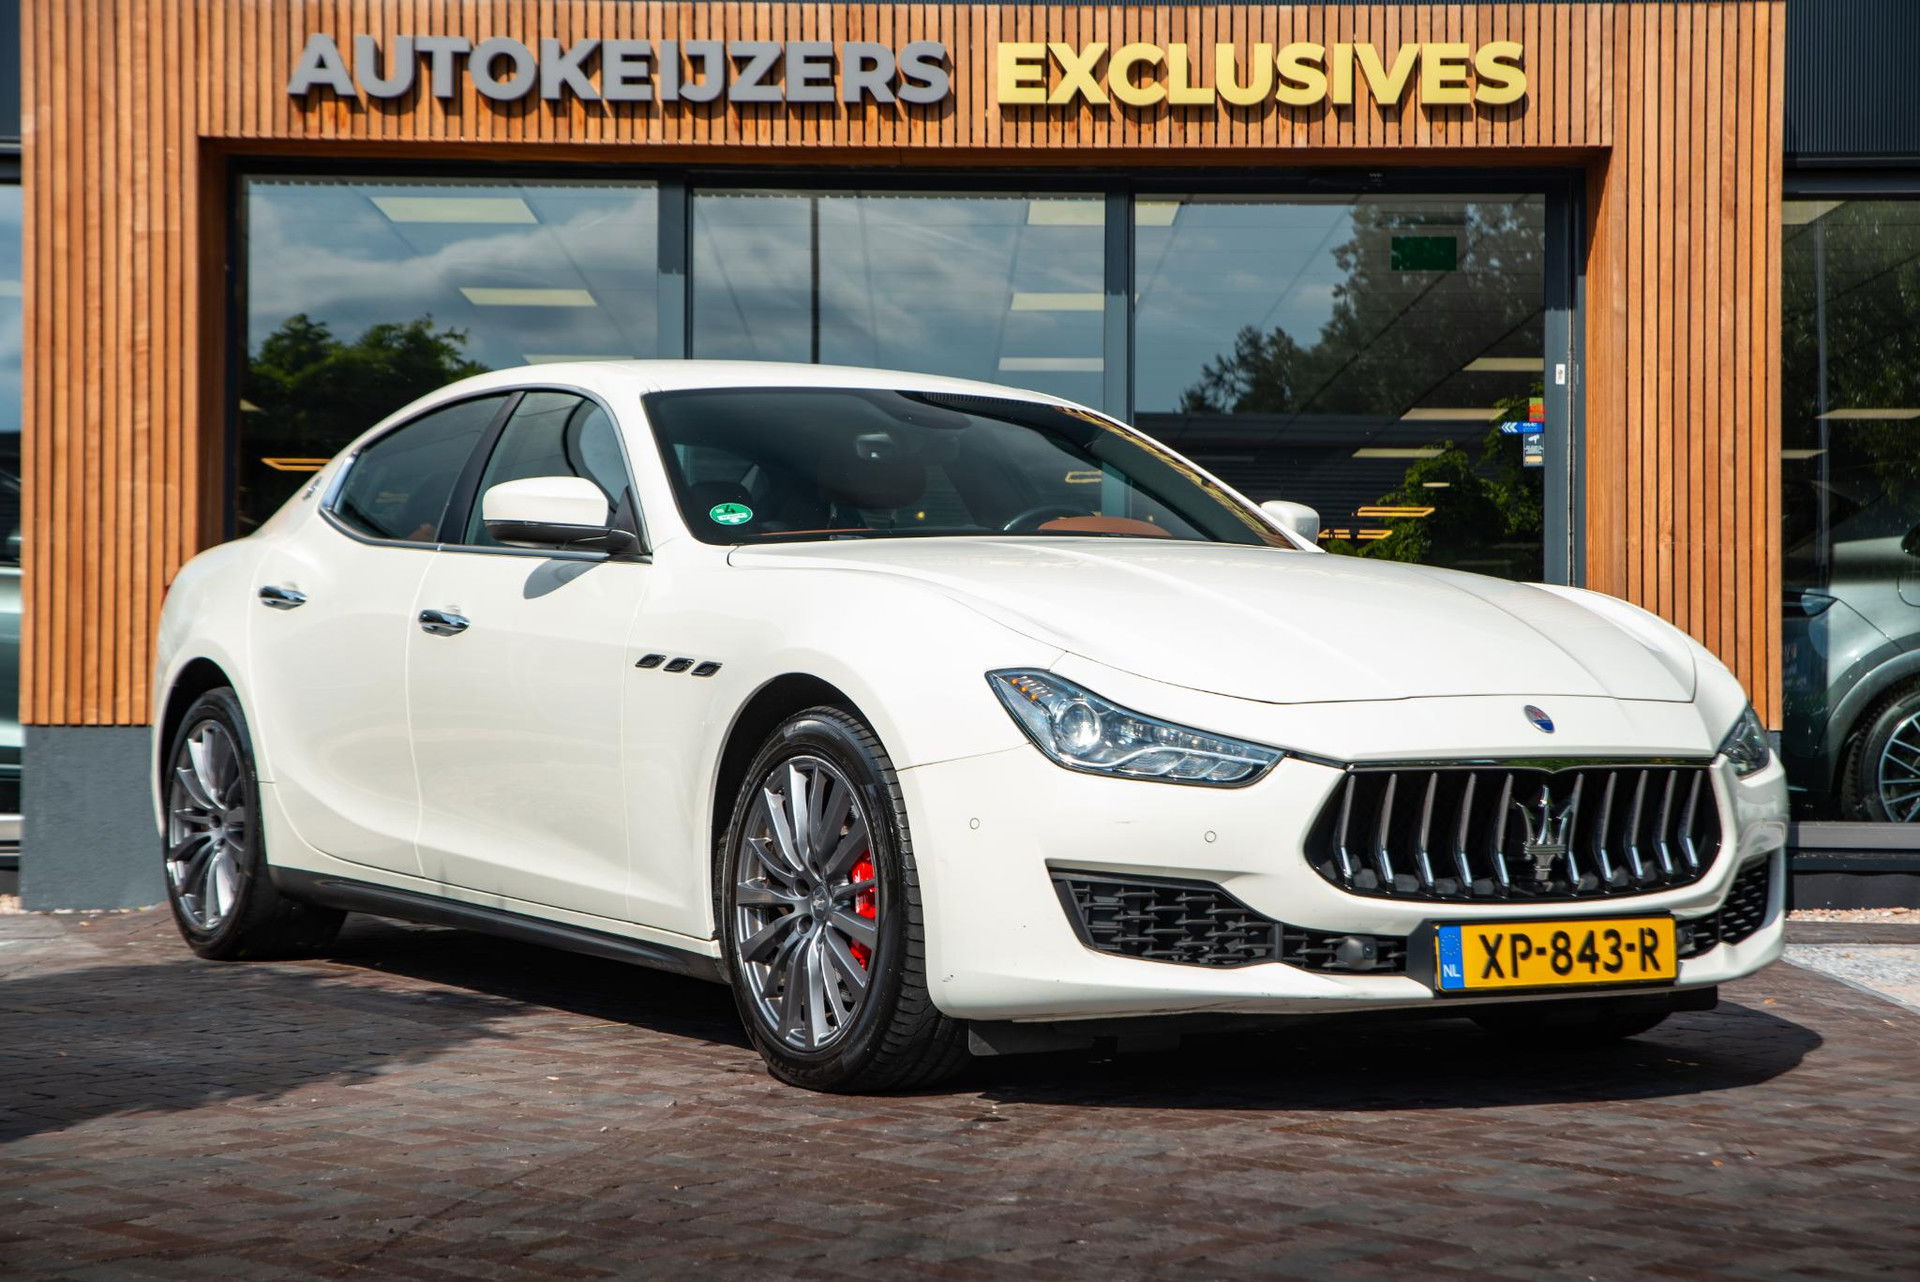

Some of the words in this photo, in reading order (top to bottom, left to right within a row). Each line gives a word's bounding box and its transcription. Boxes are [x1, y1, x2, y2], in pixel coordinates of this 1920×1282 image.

[287, 33, 952, 104] AUTOKEIJZERS
[997, 40, 1529, 106] EXCLUSIVES
[1443, 963, 1461, 978] NL
[1478, 927, 1661, 979] XP-843-R
